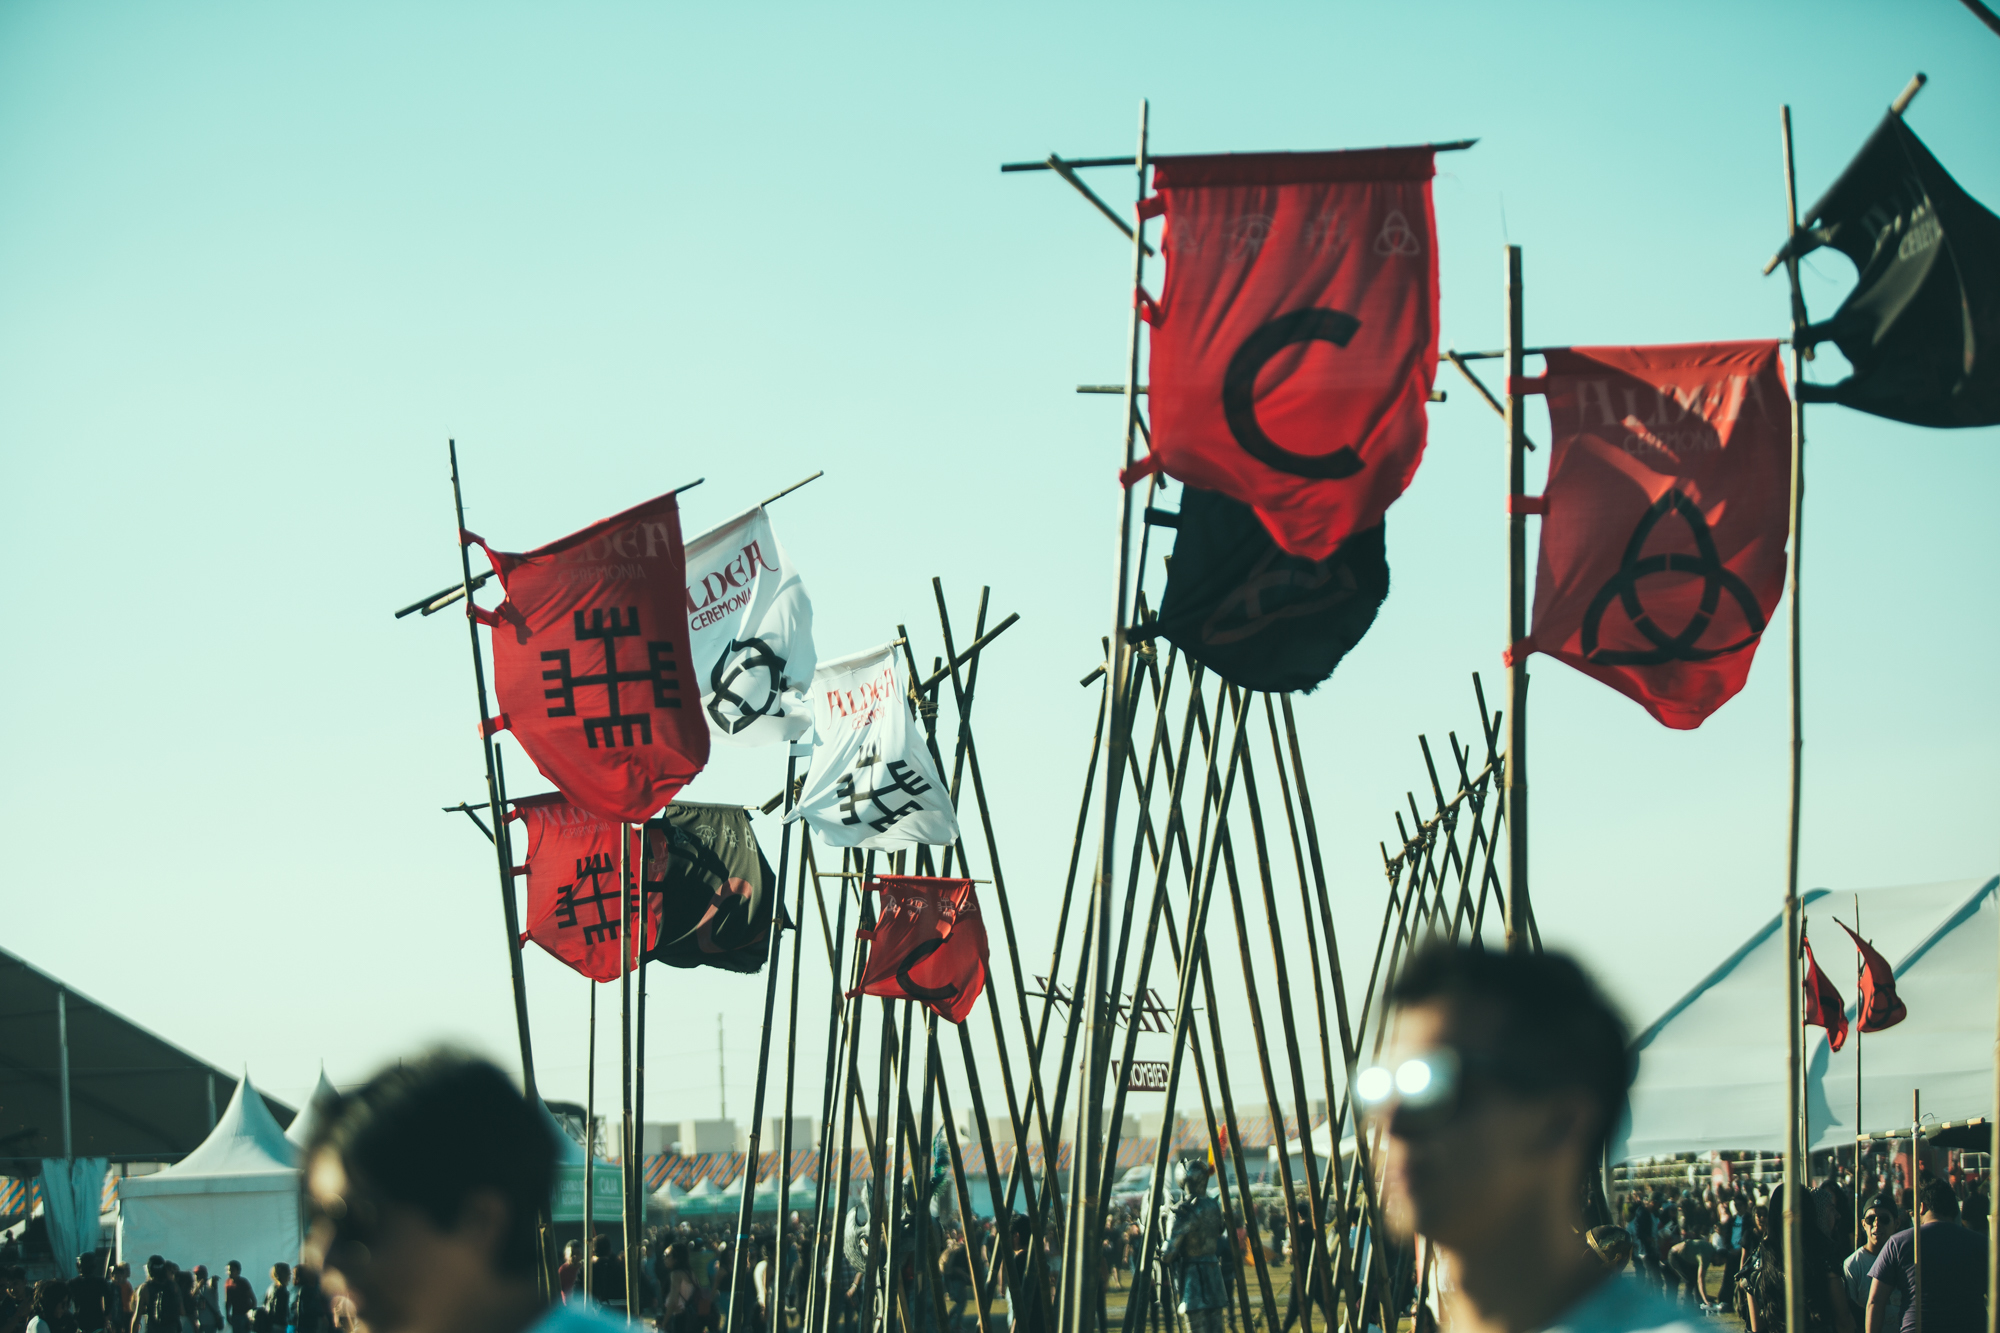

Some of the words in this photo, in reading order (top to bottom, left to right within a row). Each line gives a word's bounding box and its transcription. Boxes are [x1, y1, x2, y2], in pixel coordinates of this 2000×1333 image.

[1222, 308, 1366, 480] C
[556, 521, 680, 571] LDEA
[557, 563, 647, 584] CEREMONIA
[686, 539, 779, 616] LDEA
[827, 667, 903, 730] ALDEA
[534, 805, 599, 827] ALD
